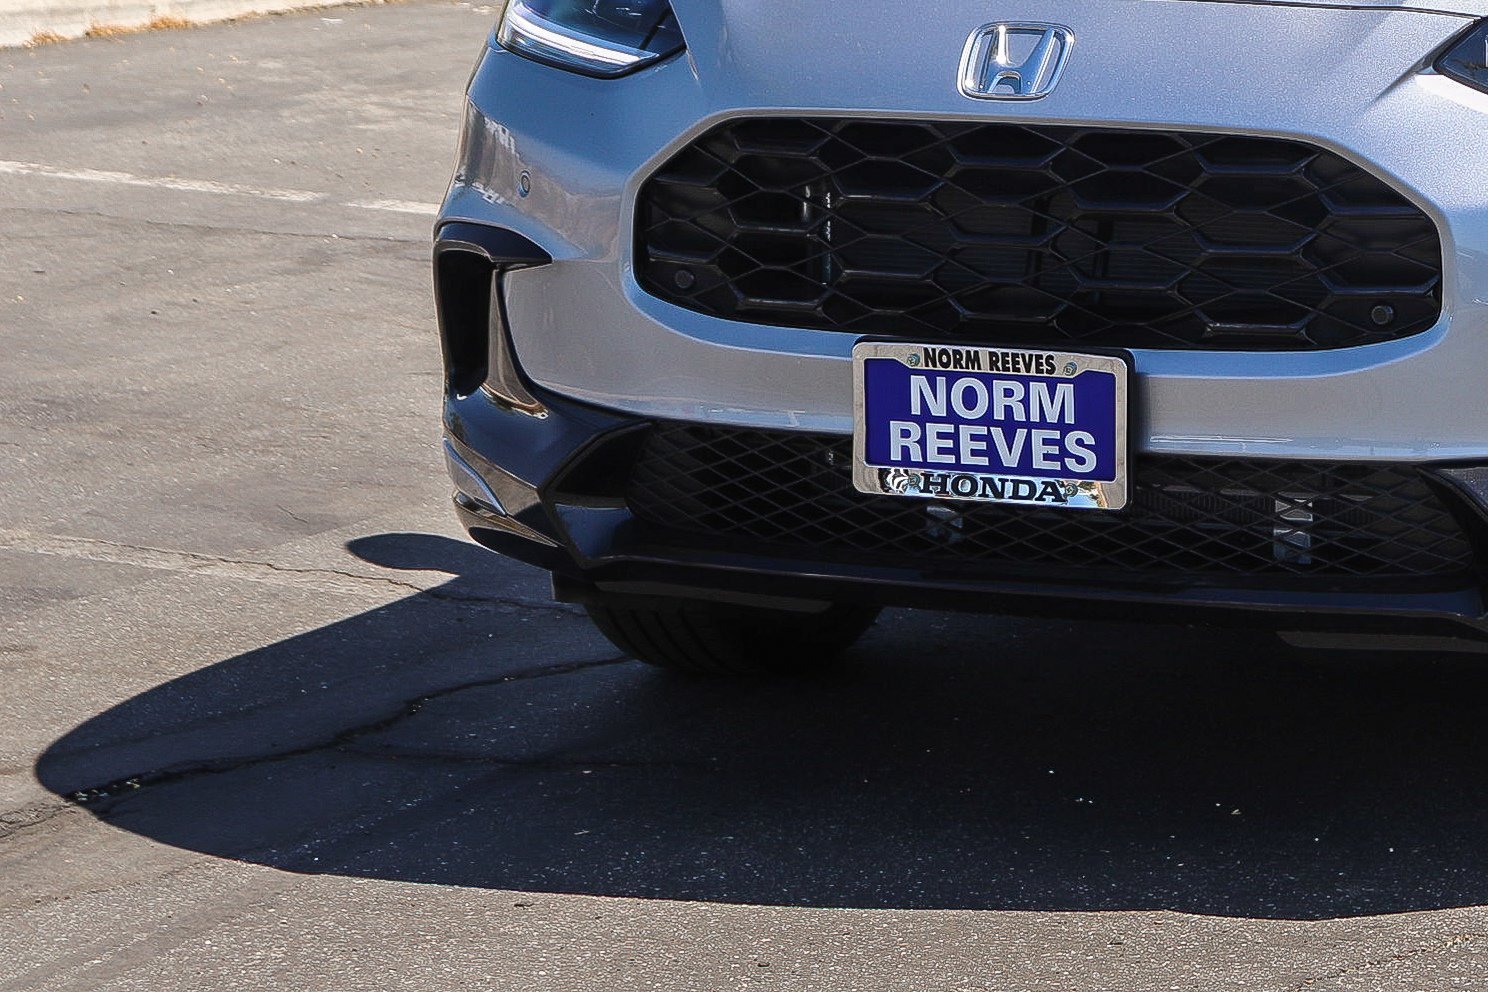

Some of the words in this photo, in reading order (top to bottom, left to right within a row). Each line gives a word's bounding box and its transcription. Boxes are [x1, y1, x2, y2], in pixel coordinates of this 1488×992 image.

[923, 347, 982, 371] NORM
[988, 352, 1056, 375] REEVES
[910, 374, 1075, 424] NORM
[889, 420, 1097, 473] REEVES
[919, 472, 1067, 503] HONDA
